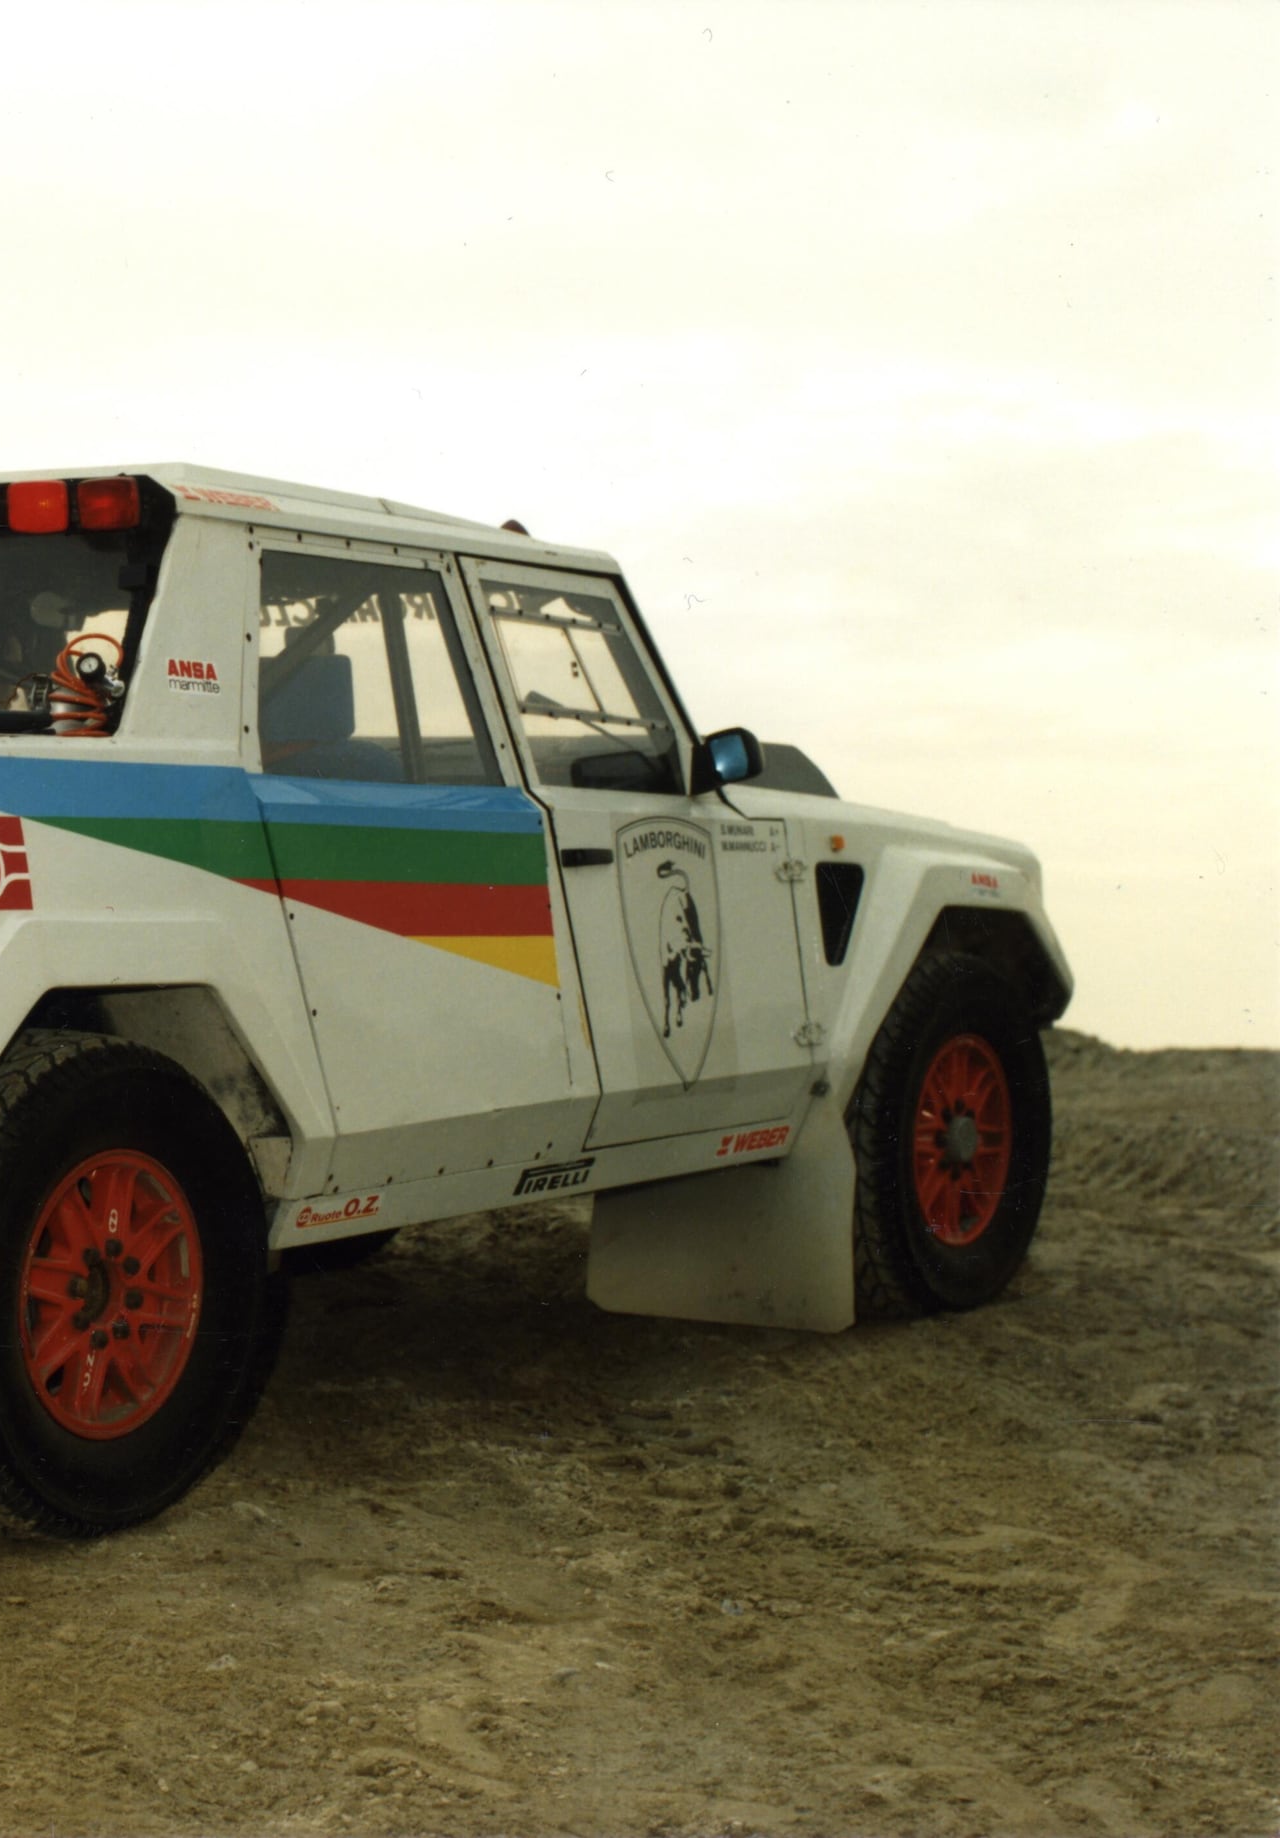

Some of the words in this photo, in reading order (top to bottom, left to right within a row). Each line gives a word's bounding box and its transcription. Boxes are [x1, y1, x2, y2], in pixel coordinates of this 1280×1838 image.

[168, 659, 218, 681] ANSA
[169, 679, 220, 694] marmitte
[624, 831, 706, 860] LAMBORGHINI
[733, 1125, 790, 1153] WEBER
[512, 1157, 595, 1196] PIRELLI
